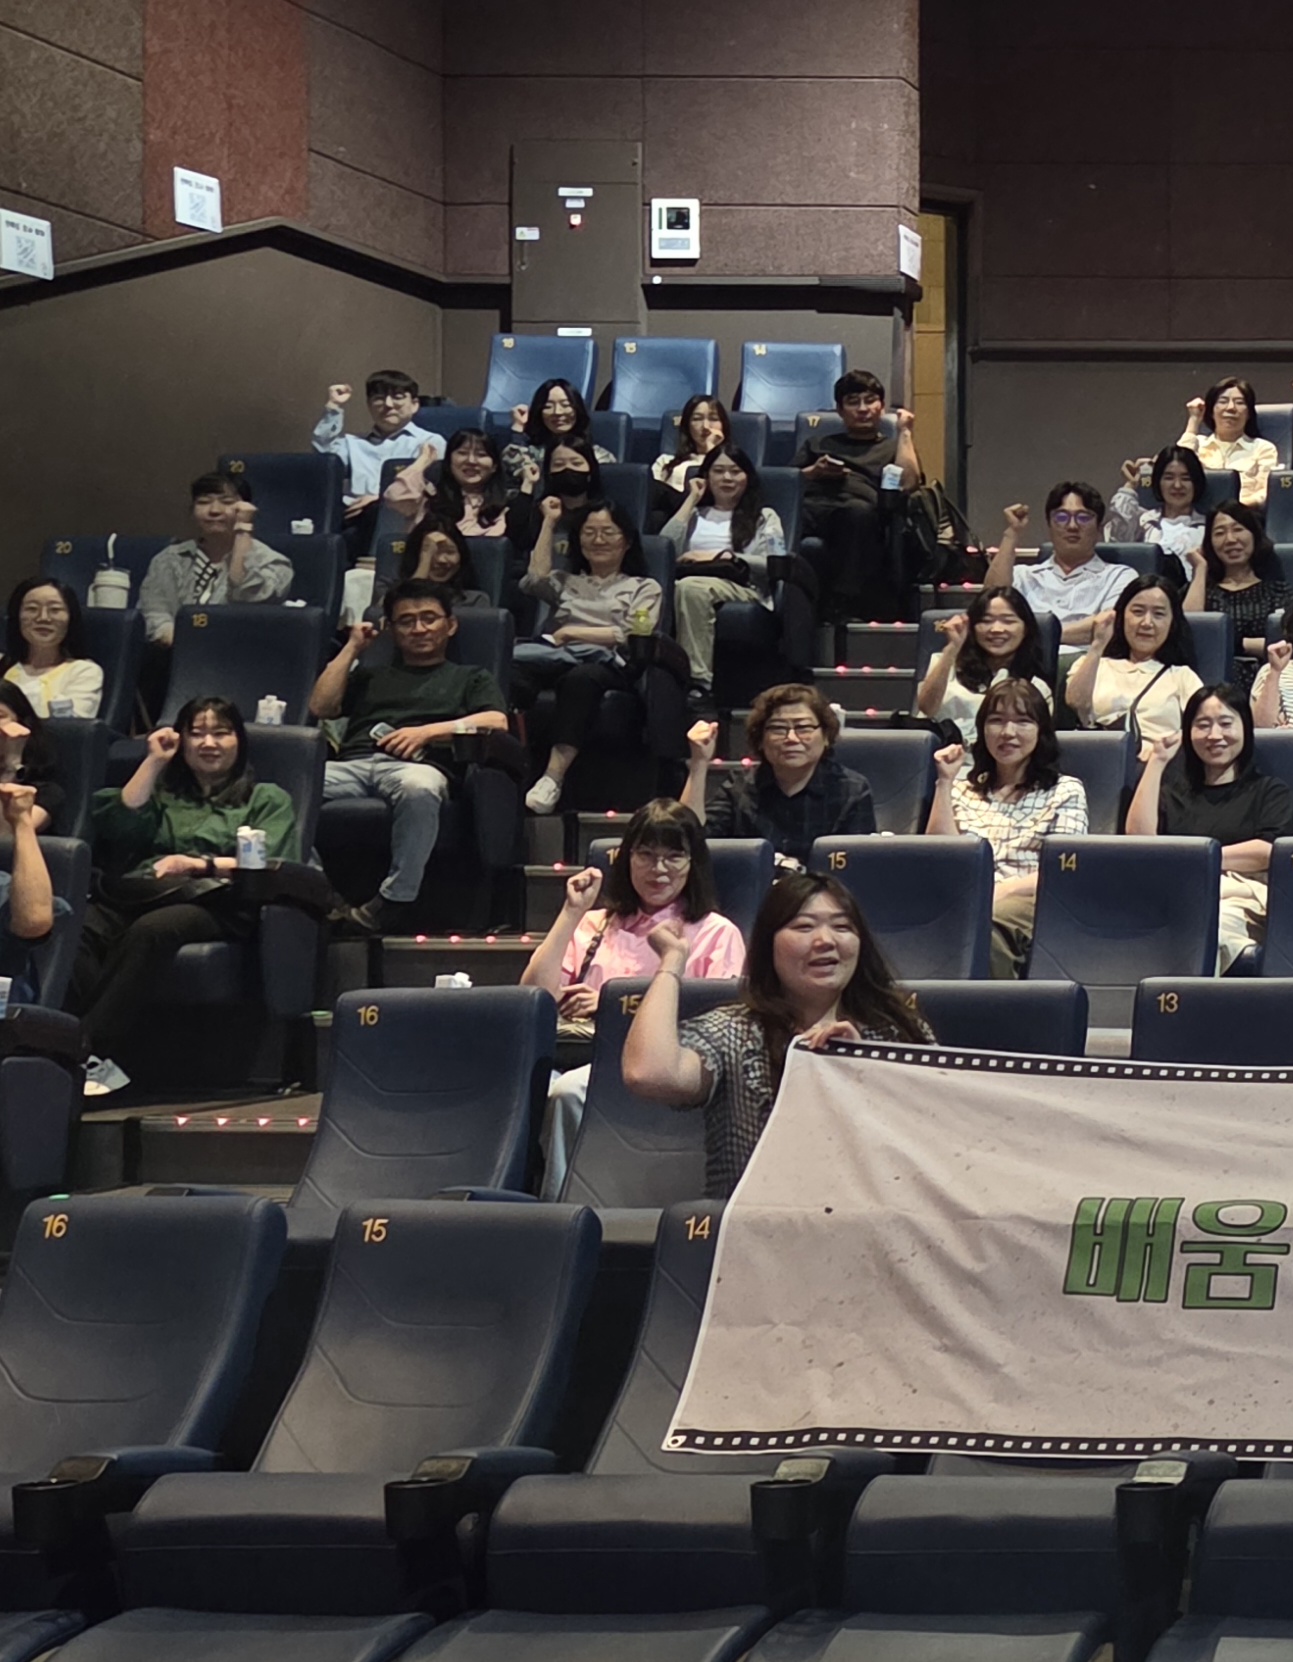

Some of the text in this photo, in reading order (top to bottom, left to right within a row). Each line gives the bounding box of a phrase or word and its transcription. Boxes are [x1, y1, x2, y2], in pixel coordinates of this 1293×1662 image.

[807, 415, 820, 428] 17
[230, 460, 244, 474] 20
[1280, 476, 1292, 488] 15
[56, 541, 72, 554] 20
[391, 541, 405, 554] 18
[192, 614, 208, 627] 18
[828, 851, 846, 869] 15
[1058, 853, 1077, 871] 14
[619, 994, 640, 1015] 15
[1157, 992, 1178, 1012] 13
[357, 1005, 378, 1025] 16
[42, 1213, 68, 1238] 16
[362, 1218, 388, 1242] 15
[686, 1216, 710, 1240] 14
